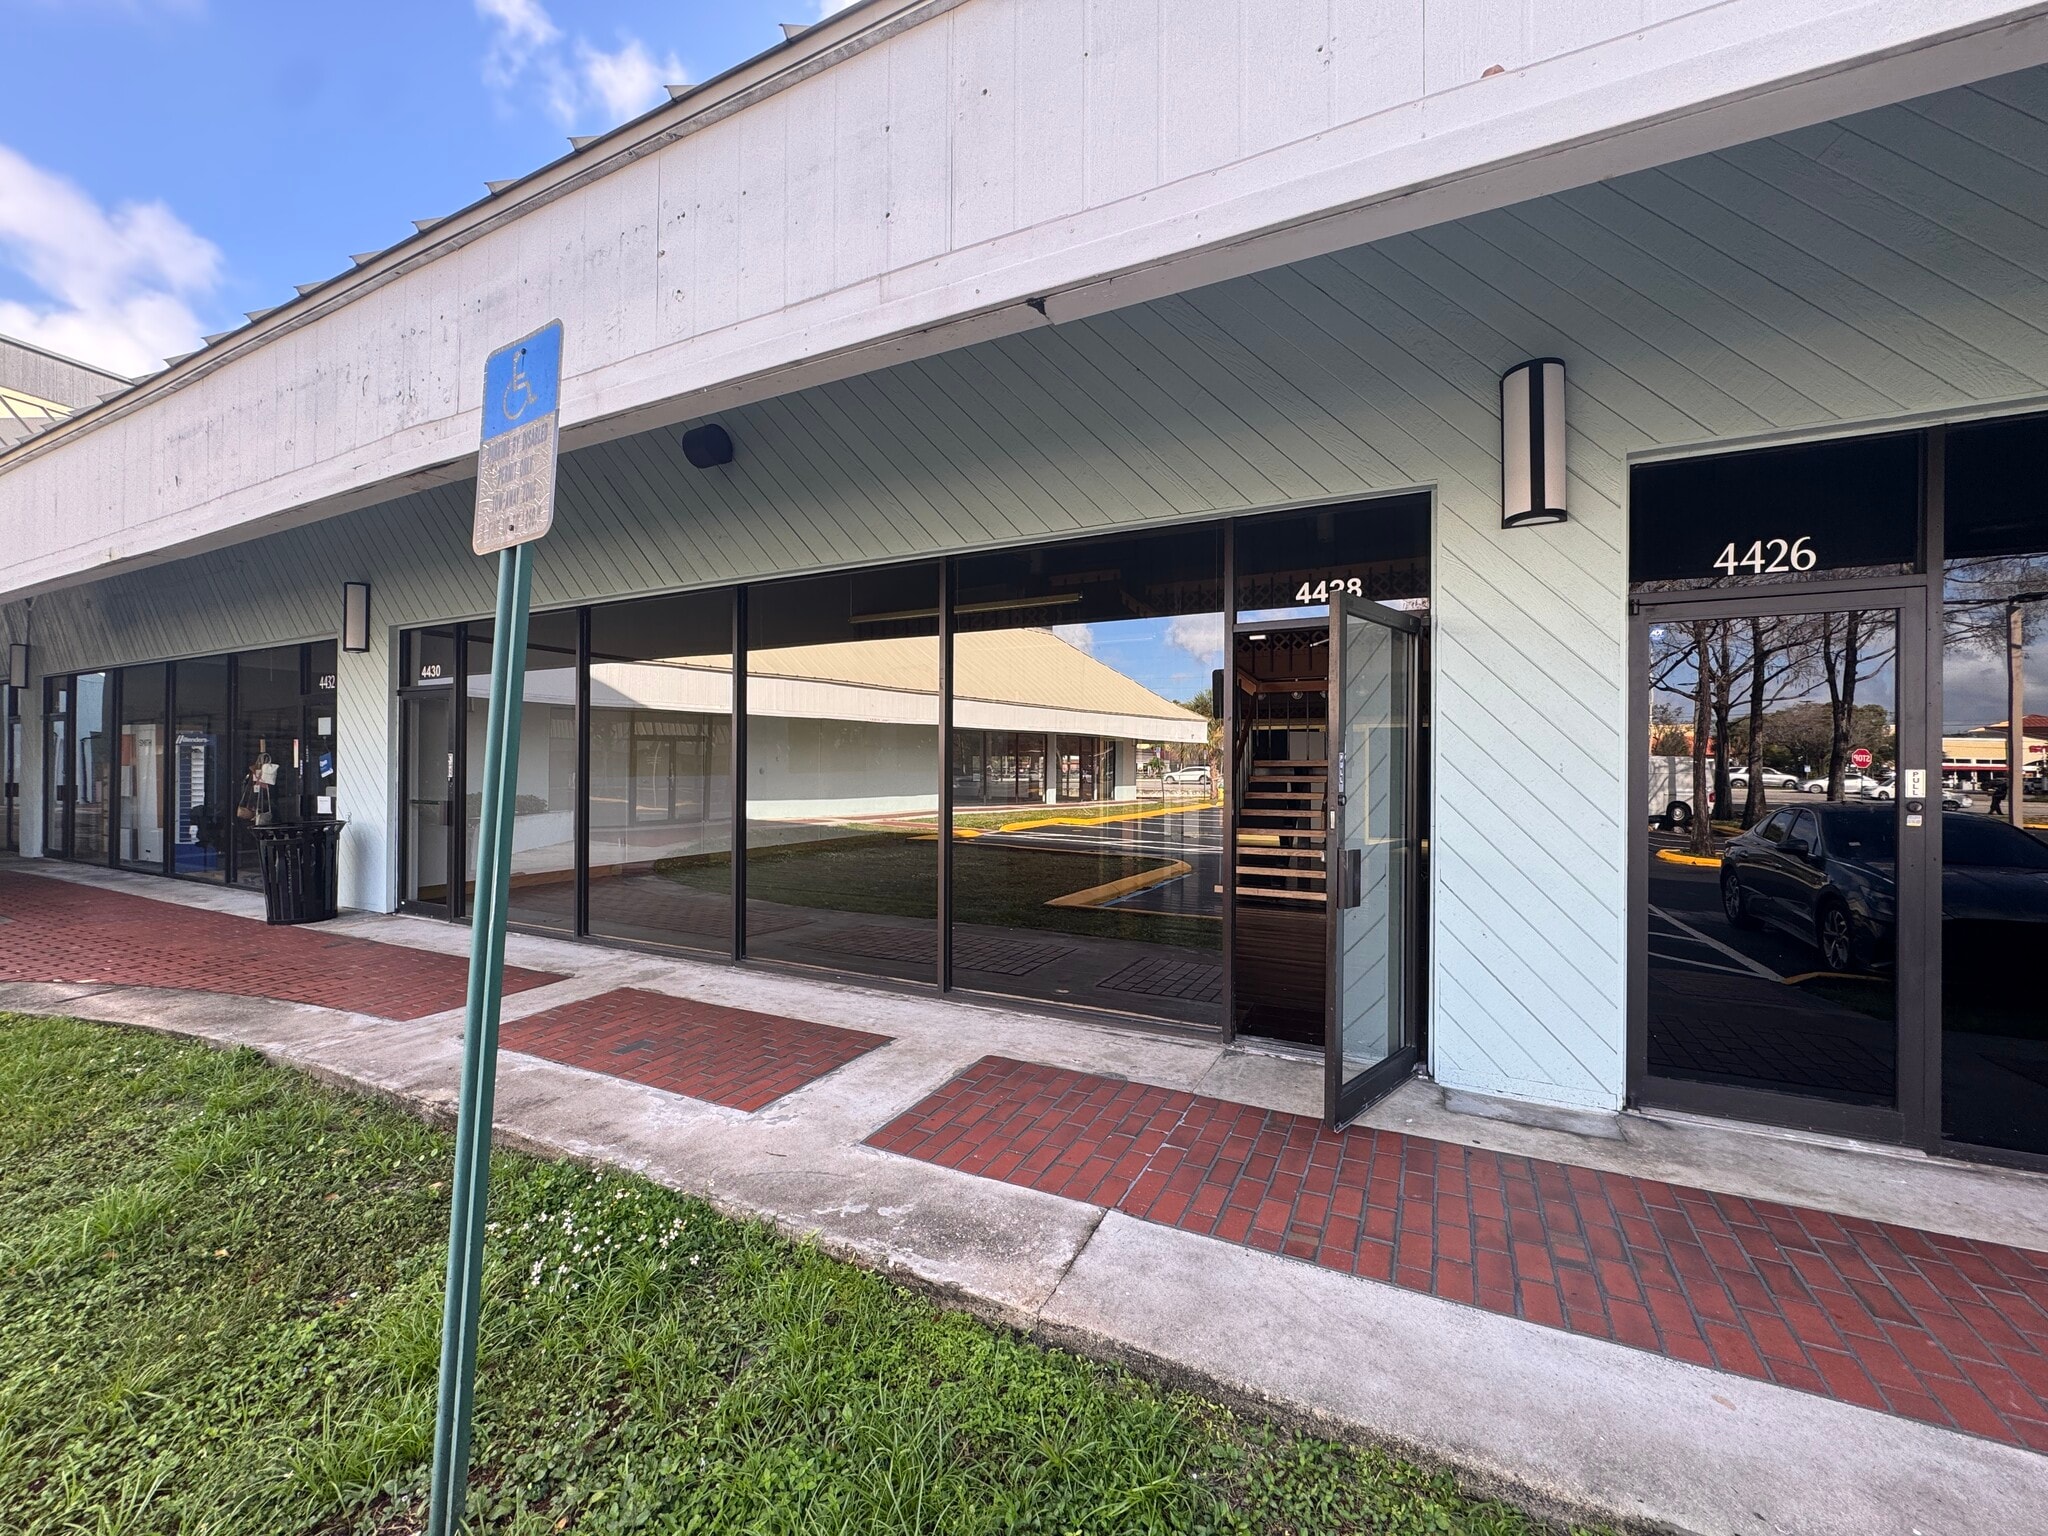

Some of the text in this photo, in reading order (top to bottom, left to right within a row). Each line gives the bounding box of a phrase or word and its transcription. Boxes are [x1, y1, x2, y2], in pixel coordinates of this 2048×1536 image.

[1713, 536, 1817, 576] 4426
[421, 664, 441, 678] 4430
[319, 675, 336, 690] 4432
[1912, 771, 1920, 796] PULL
